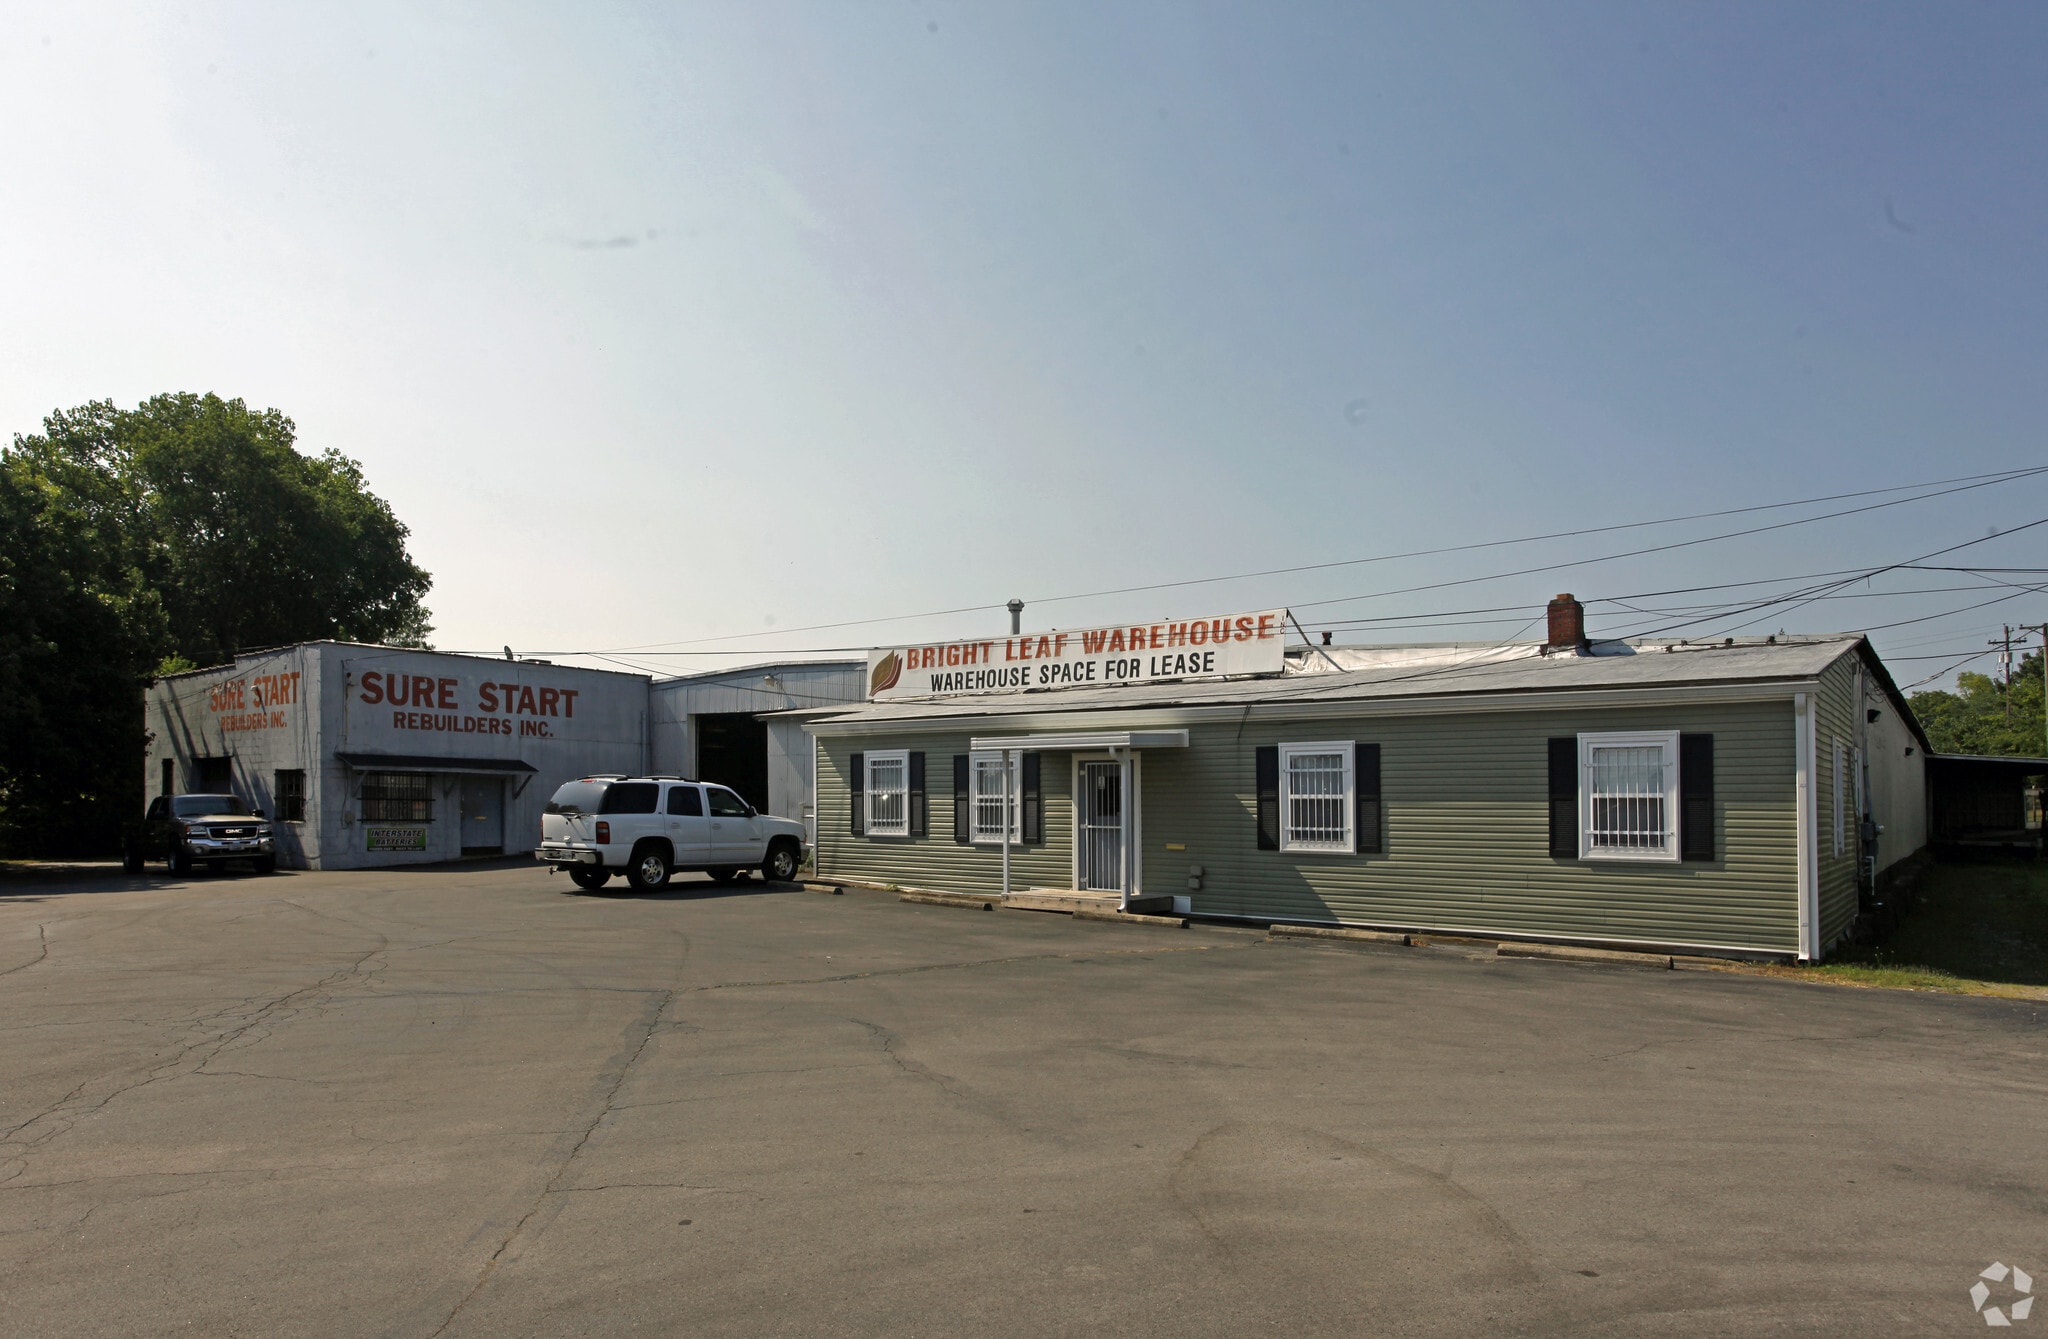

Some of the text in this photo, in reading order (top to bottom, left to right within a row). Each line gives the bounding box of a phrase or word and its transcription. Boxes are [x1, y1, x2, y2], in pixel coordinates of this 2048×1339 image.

[906, 614, 1275, 670] BRIGHT LEAF WAREHOUSE
[210, 671, 300, 712] SURE START
[931, 651, 1215, 692] WAREHOUSE SPACE FOR LEASE
[359, 671, 579, 718] SURE START
[221, 710, 287, 732] REBUILDERS INC.
[393, 711, 554, 737] REBUILDERS INC.
[375, 838, 418, 846] BATTERIES
